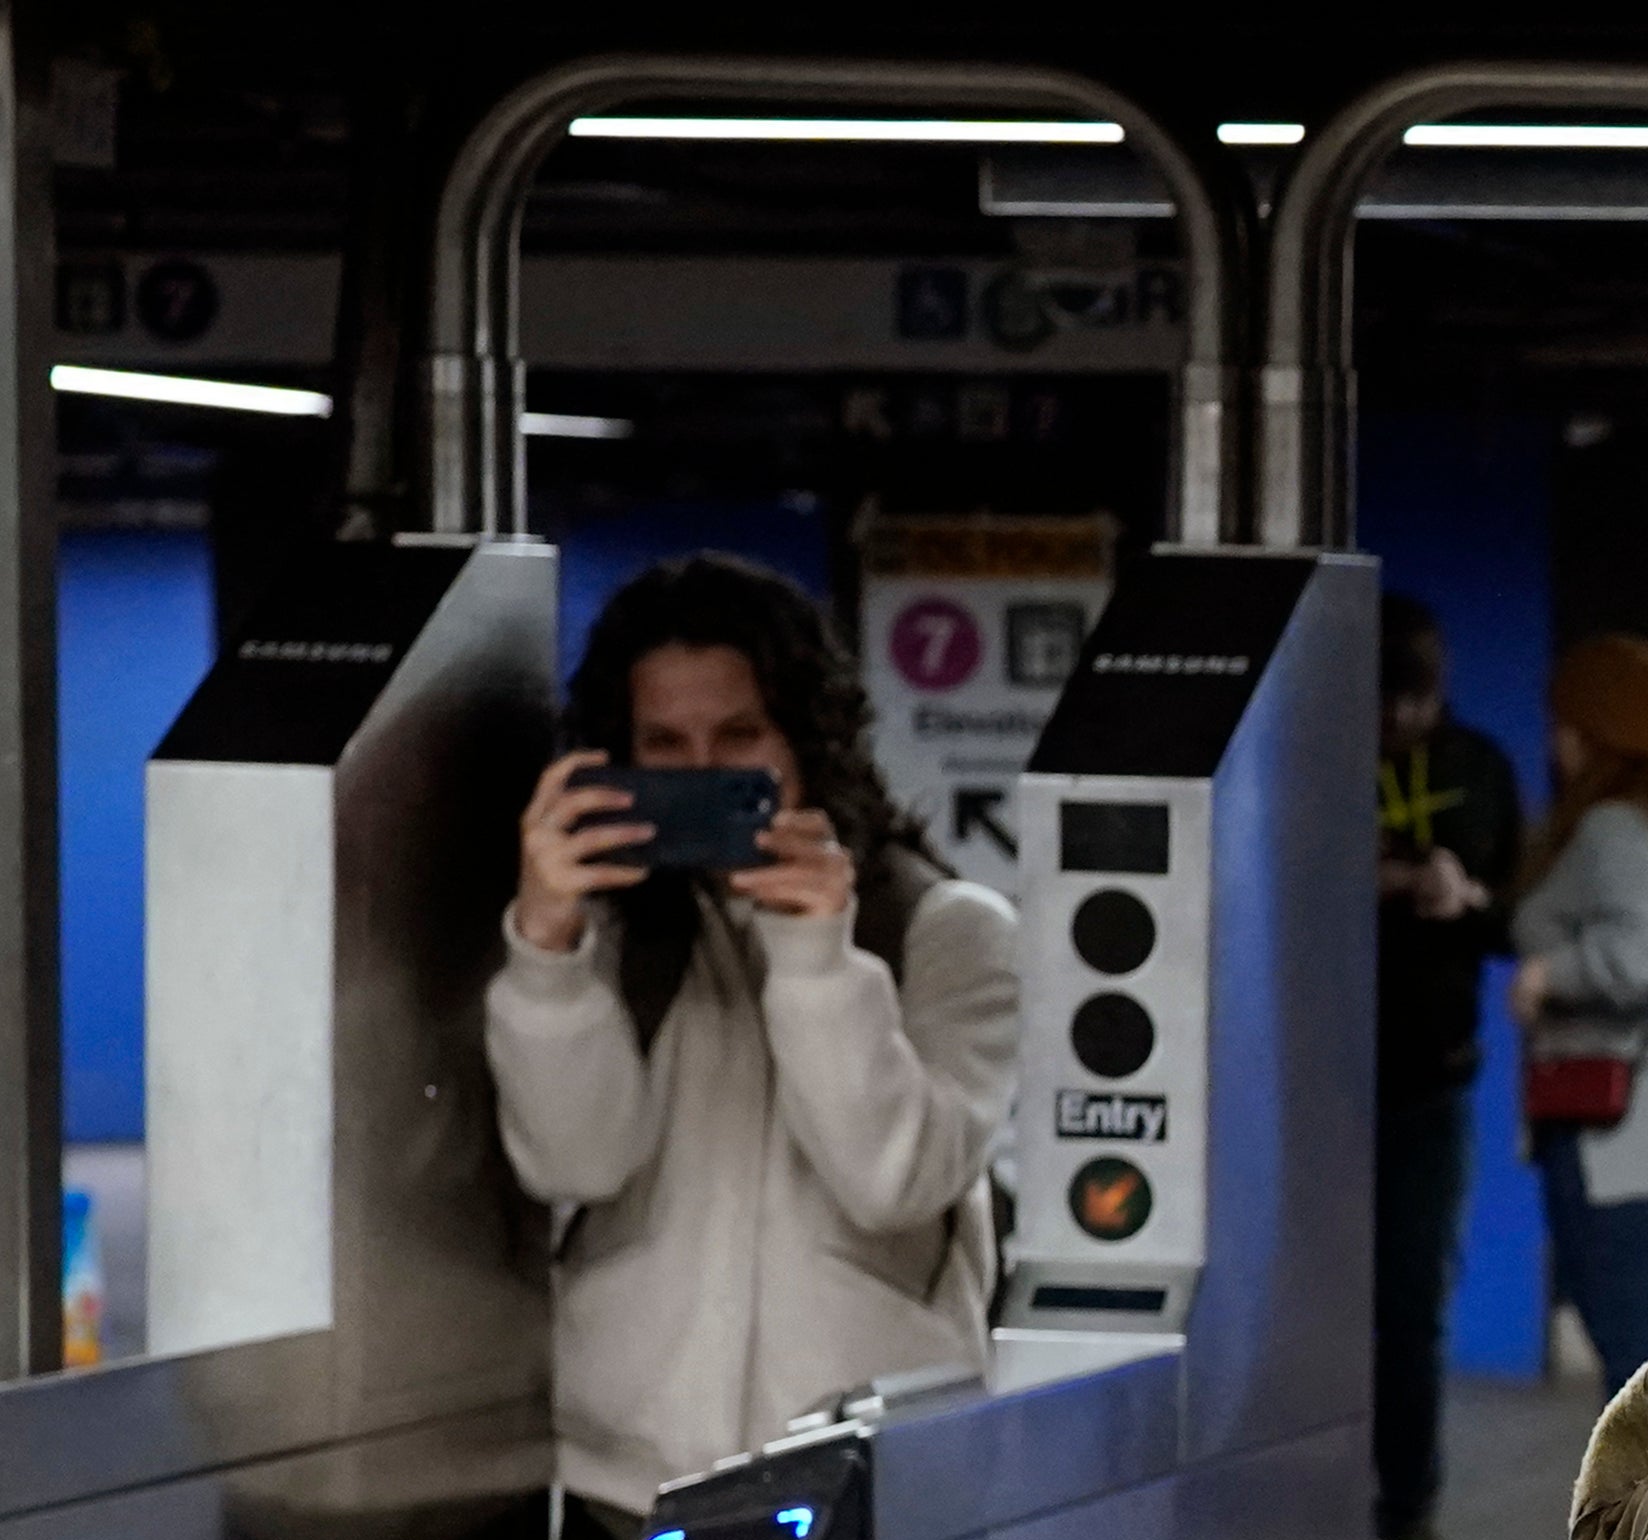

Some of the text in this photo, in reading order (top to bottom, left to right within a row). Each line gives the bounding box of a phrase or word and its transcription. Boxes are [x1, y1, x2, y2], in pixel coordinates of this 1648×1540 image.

[916, 614, 960, 677] 7
[1092, 653, 1251, 675] SAMSUNG
[1059, 1092, 1165, 1144] Entry
